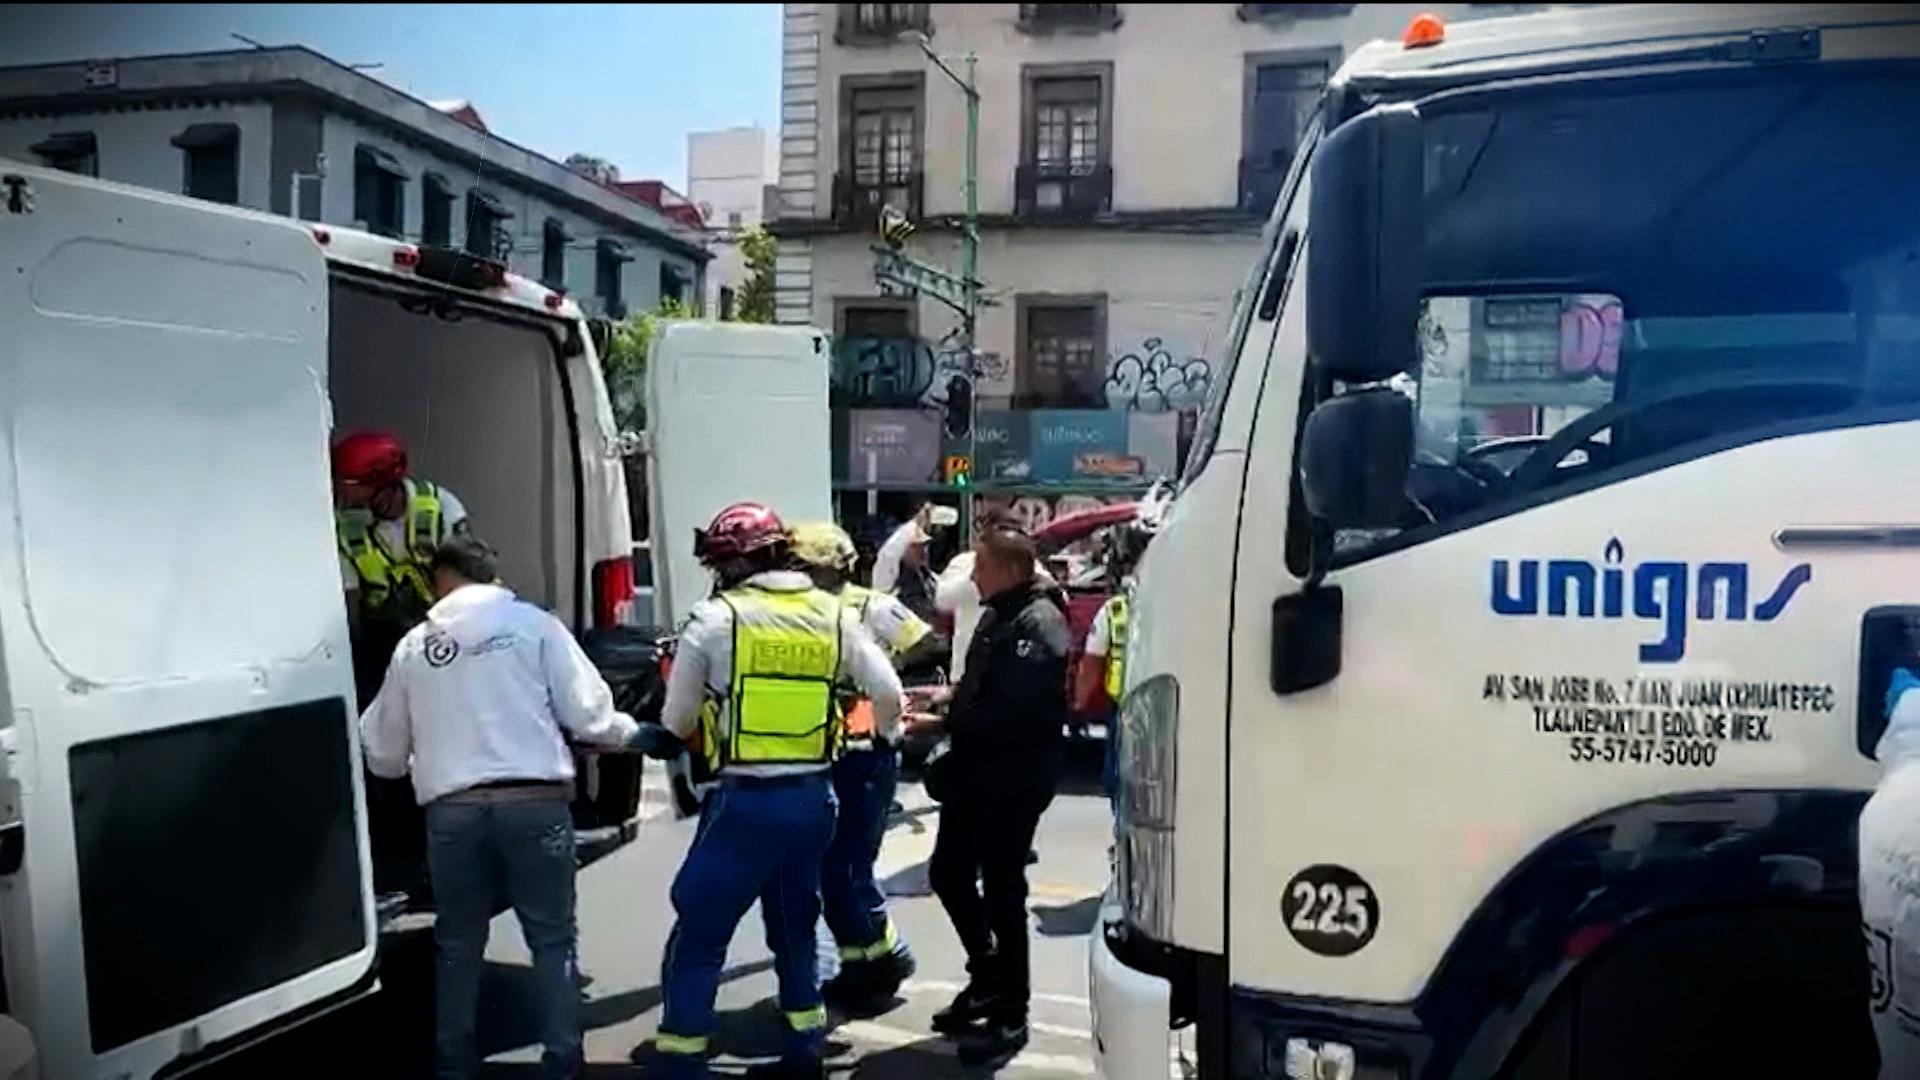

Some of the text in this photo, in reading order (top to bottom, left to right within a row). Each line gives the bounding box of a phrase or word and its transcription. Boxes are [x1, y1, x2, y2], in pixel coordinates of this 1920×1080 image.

[1510, 674, 1544, 701] SAN
[1678, 680, 1722, 707] JUAN
[1704, 713, 1727, 739] DE
[1570, 737, 1717, 767] 55-5747-5000
[1291, 880, 1368, 938] 225
